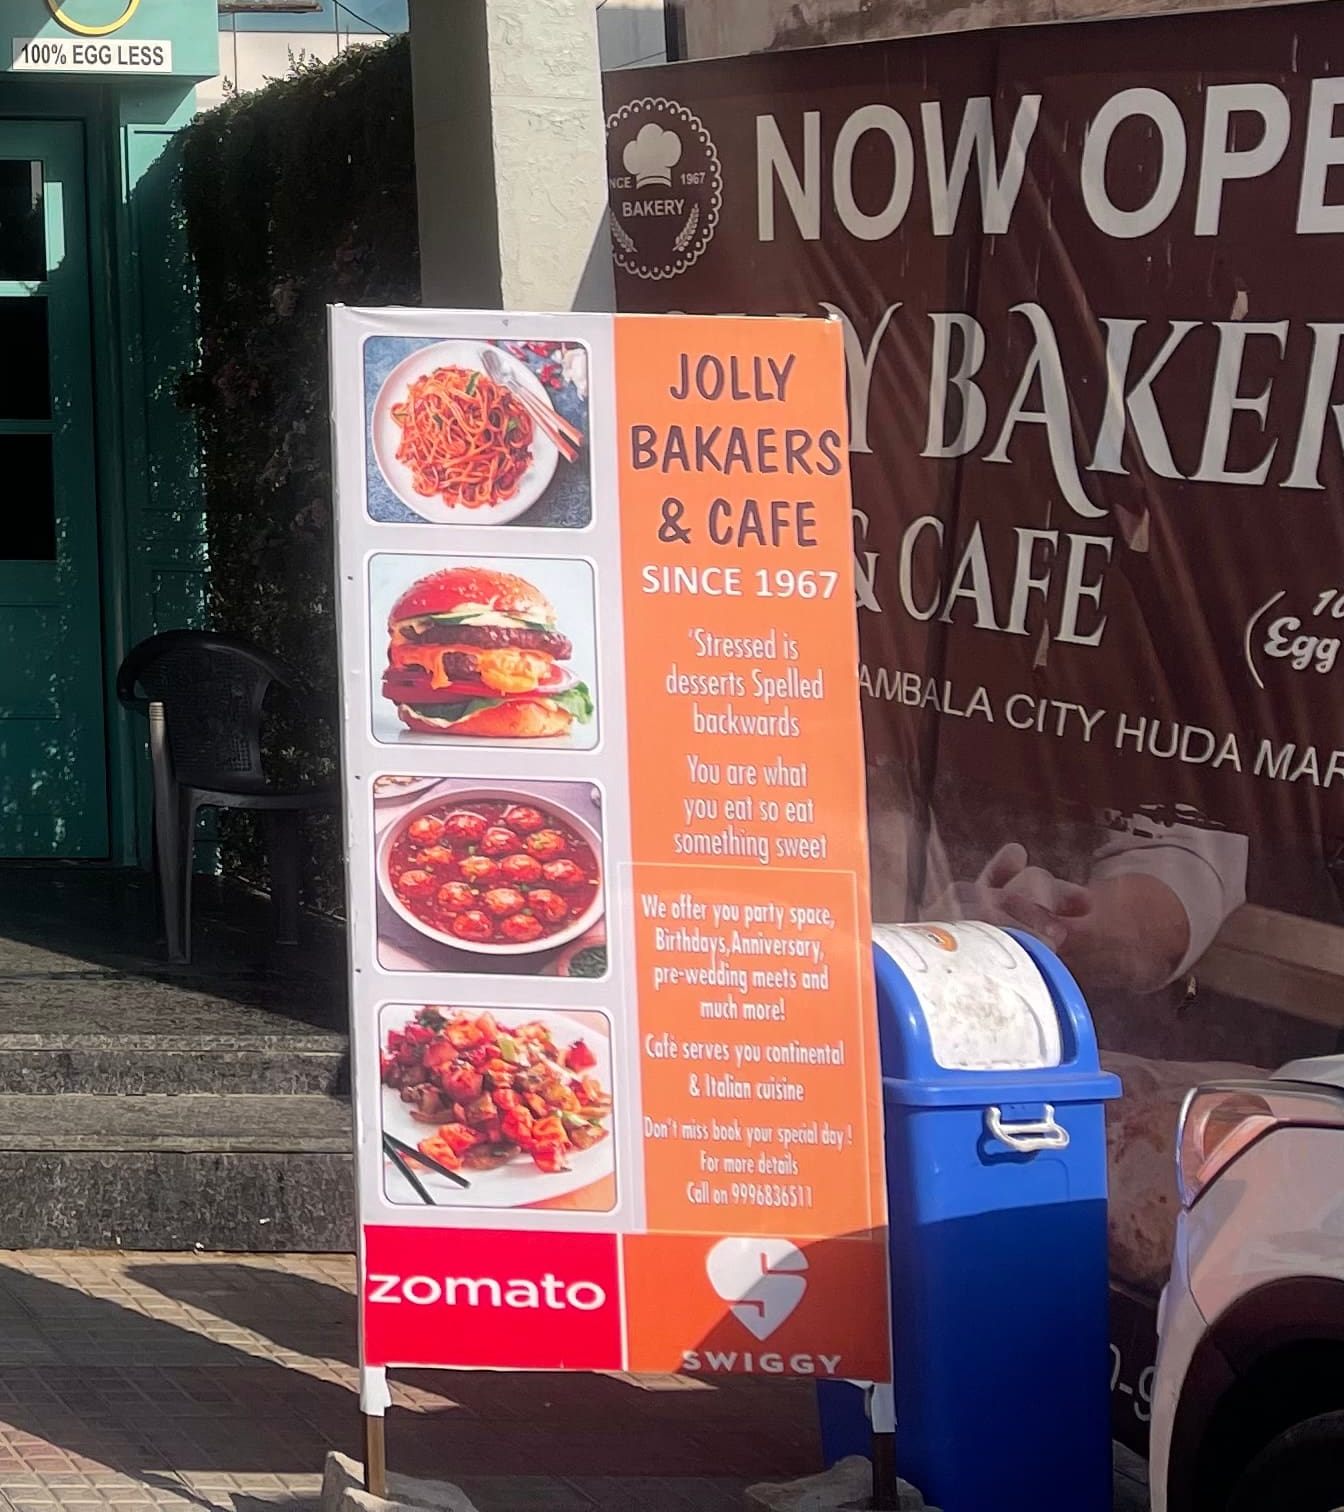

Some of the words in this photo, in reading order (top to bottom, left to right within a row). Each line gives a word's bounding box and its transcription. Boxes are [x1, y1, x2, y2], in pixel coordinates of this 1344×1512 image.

[21, 43, 67, 64] 100%
[72, 44, 112, 65] EGG
[117, 45, 164, 66] LESS
[680, 172, 706, 185] 1967
[755, 94, 1041, 242] NOW
[622, 199, 685, 217] BAKERY
[669, 353, 796, 402] JOLLY
[631, 424, 842, 476] BAKAERS
[657, 497, 691, 544] &
[708, 498, 818, 548] CAFE
[641, 565, 742, 596] SINCE
[755, 568, 839, 599] 1967
[898, 514, 1114, 648] CAFE
[783, 632, 800, 660] is
[1264, 616, 1341, 674] Egg
[666, 663, 746, 697] desserts
[751, 667, 824, 705] Spelled
[692, 702, 800, 737] backwards
[858, 664, 994, 722] AMBALA
[1004, 693, 1106, 742] CITY
[1115, 713, 1242, 772] HUDA
[687, 754, 720, 785] You
[726, 763, 757, 786] are
[763, 756, 807, 787] what
[684, 798, 717, 825] you
[724, 795, 753, 821] eat
[760, 801, 779, 822] so
[785, 798, 814, 824] eat
[674, 824, 769, 865] something
[776, 833, 828, 859] sweet
[641, 894, 667, 918] We
[671, 894, 706, 920] offer
[712, 903, 739, 928] you
[745, 903, 784, 930] party
[790, 906, 835, 930] space,
[654, 961, 747, 993] pre-wedding
[753, 967, 797, 988] meets
[802, 964, 829, 990] and
[700, 994, 738, 1020] much
[743, 997, 785, 1021] more!
[683, 1042, 729, 1061] serves
[735, 1044, 761, 1068] you
[766, 1040, 845, 1065] continental
[689, 1073, 700, 1097] &
[705, 1073, 751, 1099] Italian
[757, 1077, 804, 1101] cuisine
[643, 1116, 678, 1138] Don't
[682, 1120, 709, 1140] miss
[713, 1119, 742, 1141] book
[746, 1126, 773, 1148] your
[778, 1121, 818, 1149] special
[700, 1150, 719, 1172] For
[724, 1158, 754, 1174] more
[758, 1150, 799, 1175] details
[687, 1181, 709, 1204] Call
[714, 1189, 728, 1205] on
[368, 1271, 606, 1311] zomato
[681, 1350, 844, 1375] SWIGGY
